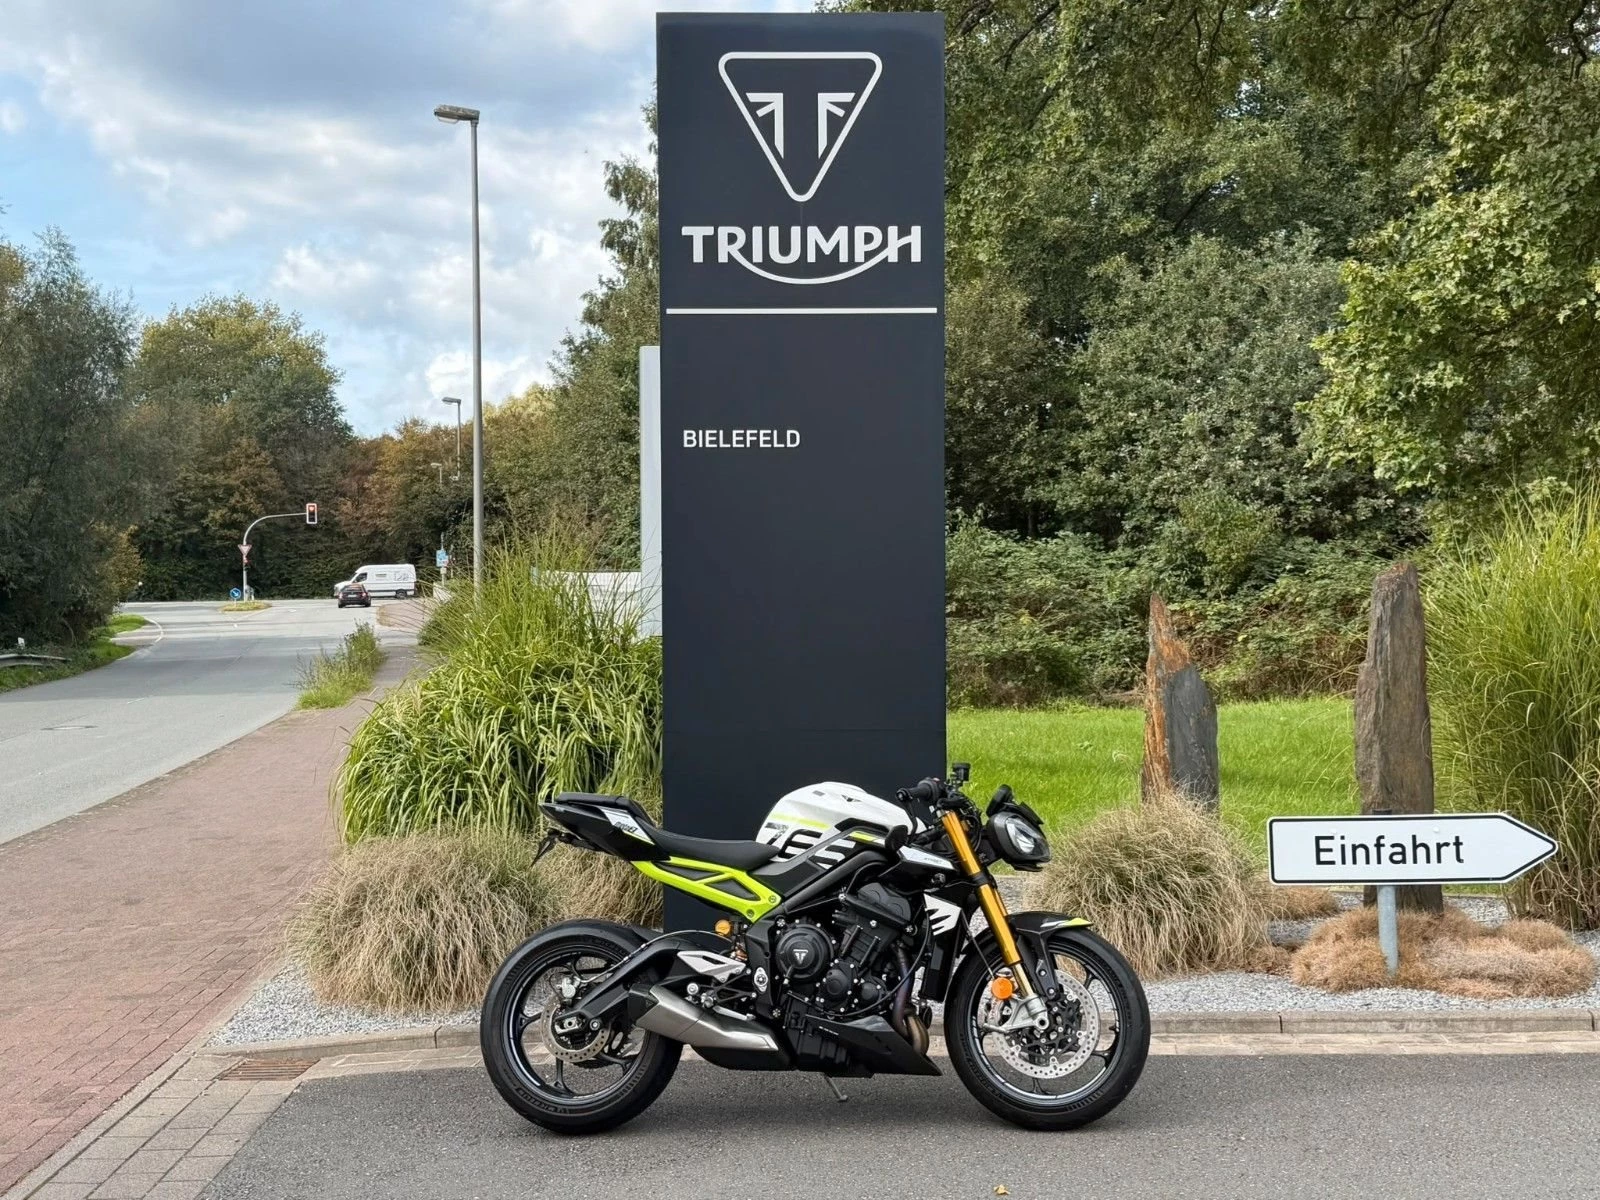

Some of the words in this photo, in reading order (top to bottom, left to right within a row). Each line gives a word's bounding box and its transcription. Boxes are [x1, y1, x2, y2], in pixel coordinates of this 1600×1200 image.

[682, 226, 922, 285] TRIUMPH
[682, 429, 801, 448] BIELEFELD
[1314, 835, 1464, 866] Einfahrt
